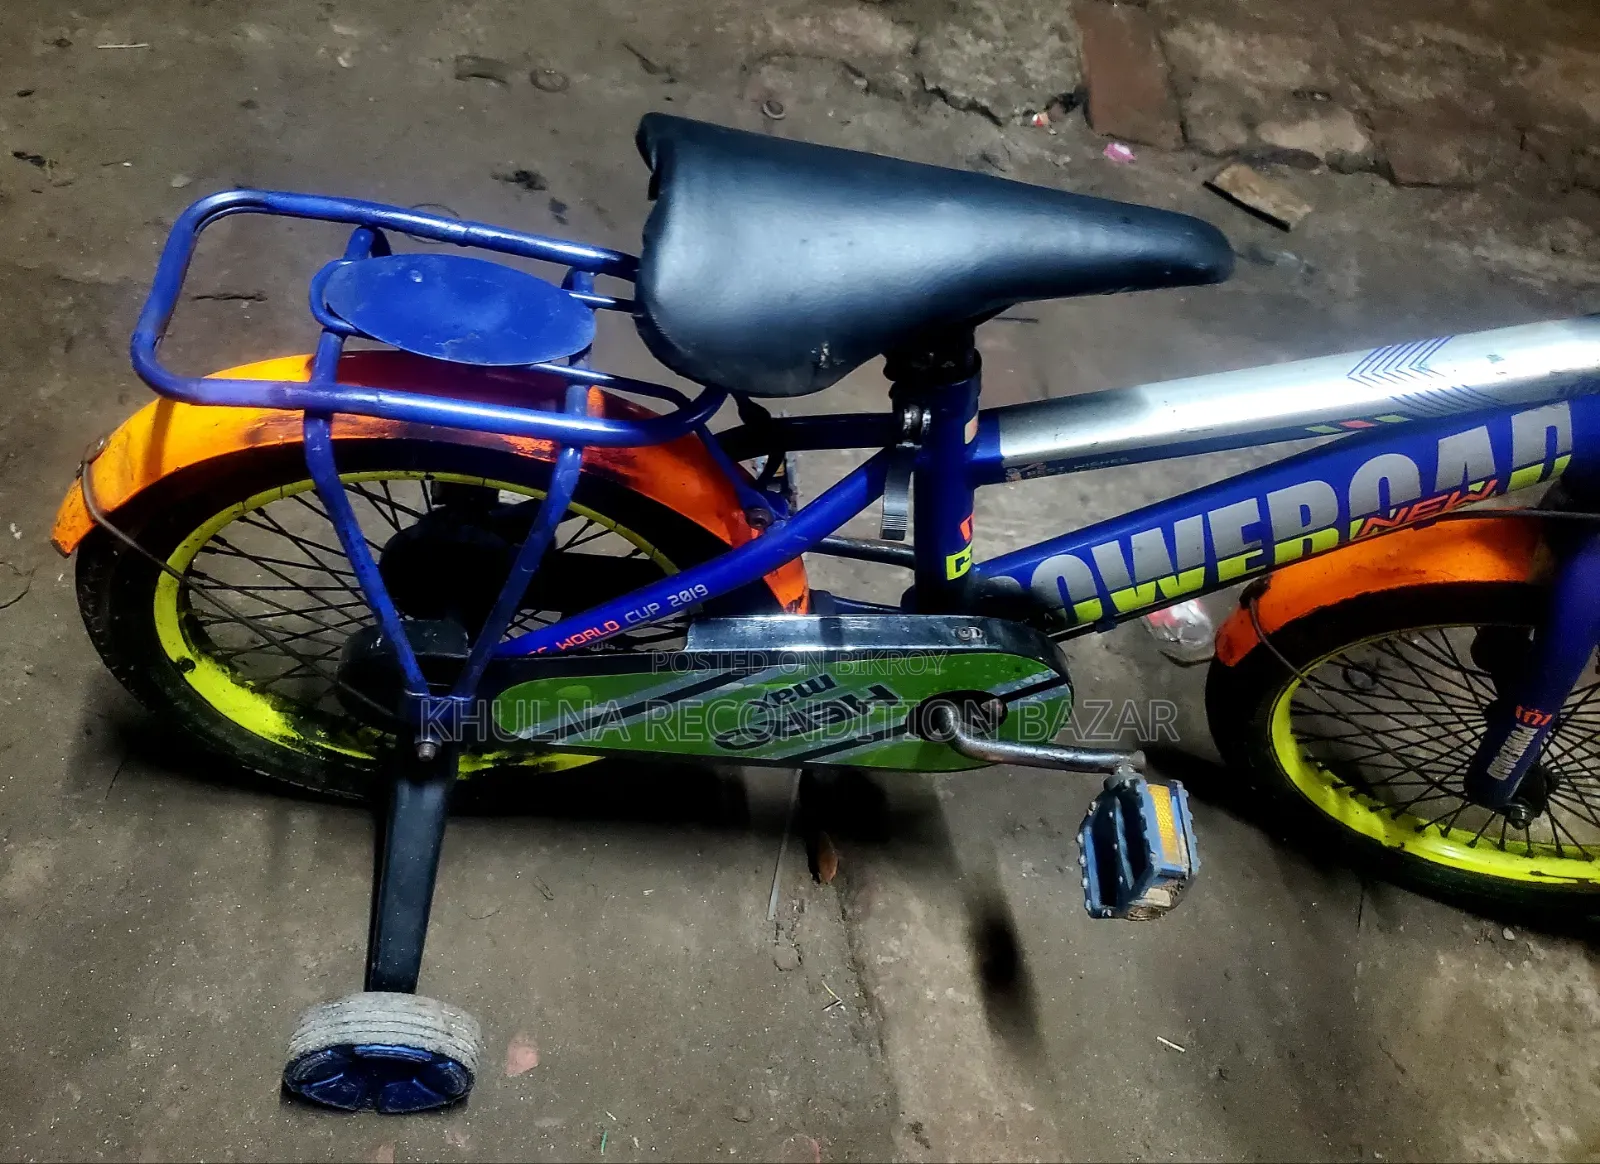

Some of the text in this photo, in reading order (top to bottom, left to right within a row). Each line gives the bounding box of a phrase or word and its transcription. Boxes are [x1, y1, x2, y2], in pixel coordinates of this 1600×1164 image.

[1358, 479, 1498, 537] NEW
[556, 584, 709, 650] WORLD CUP 2019
